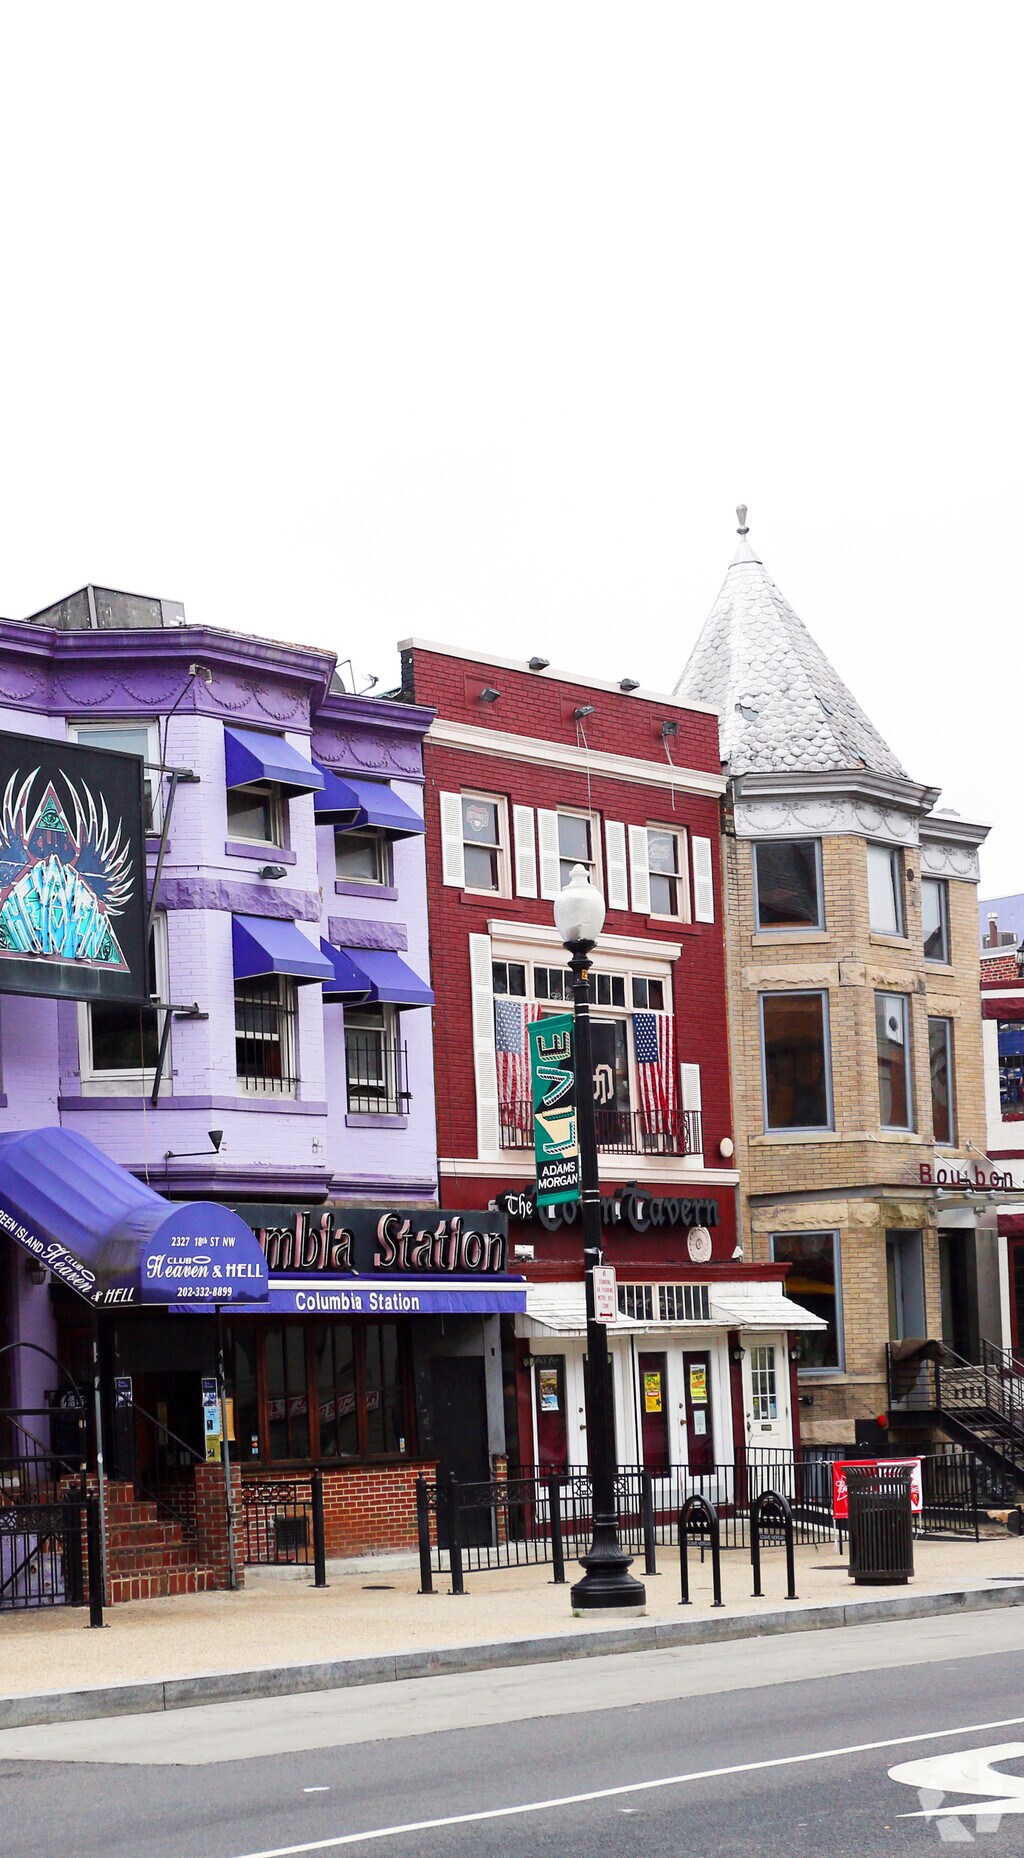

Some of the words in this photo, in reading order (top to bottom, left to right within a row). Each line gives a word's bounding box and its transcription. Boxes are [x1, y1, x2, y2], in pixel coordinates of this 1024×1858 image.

[541, 1161, 576, 1177] ADAMS
[538, 1174, 578, 1190] MORGAN
[505, 1193, 533, 1218] The
[623, 1182, 720, 1232] Tavern
[14, 1225, 44, 1254] ISLAND
[171, 1236, 190, 1247] 2327
[194, 1236, 207, 1247] 18th
[210, 1236, 220, 1247] ST
[222, 1236, 236, 1247] NW
[374, 1212, 507, 1273] Station
[41, 1243, 93, 1293] Heaven
[64, 1252, 84, 1271] CLUB
[146, 1254, 209, 1278] Heaven
[212, 1264, 223, 1278] &
[225, 1263, 263, 1278] HELL
[91, 1291, 103, 1302] &
[104, 1287, 135, 1304] HELL
[177, 1286, 233, 1297] 202-332-8899
[295, 1292, 362, 1310] Columbia
[369, 1292, 420, 1310] Station
